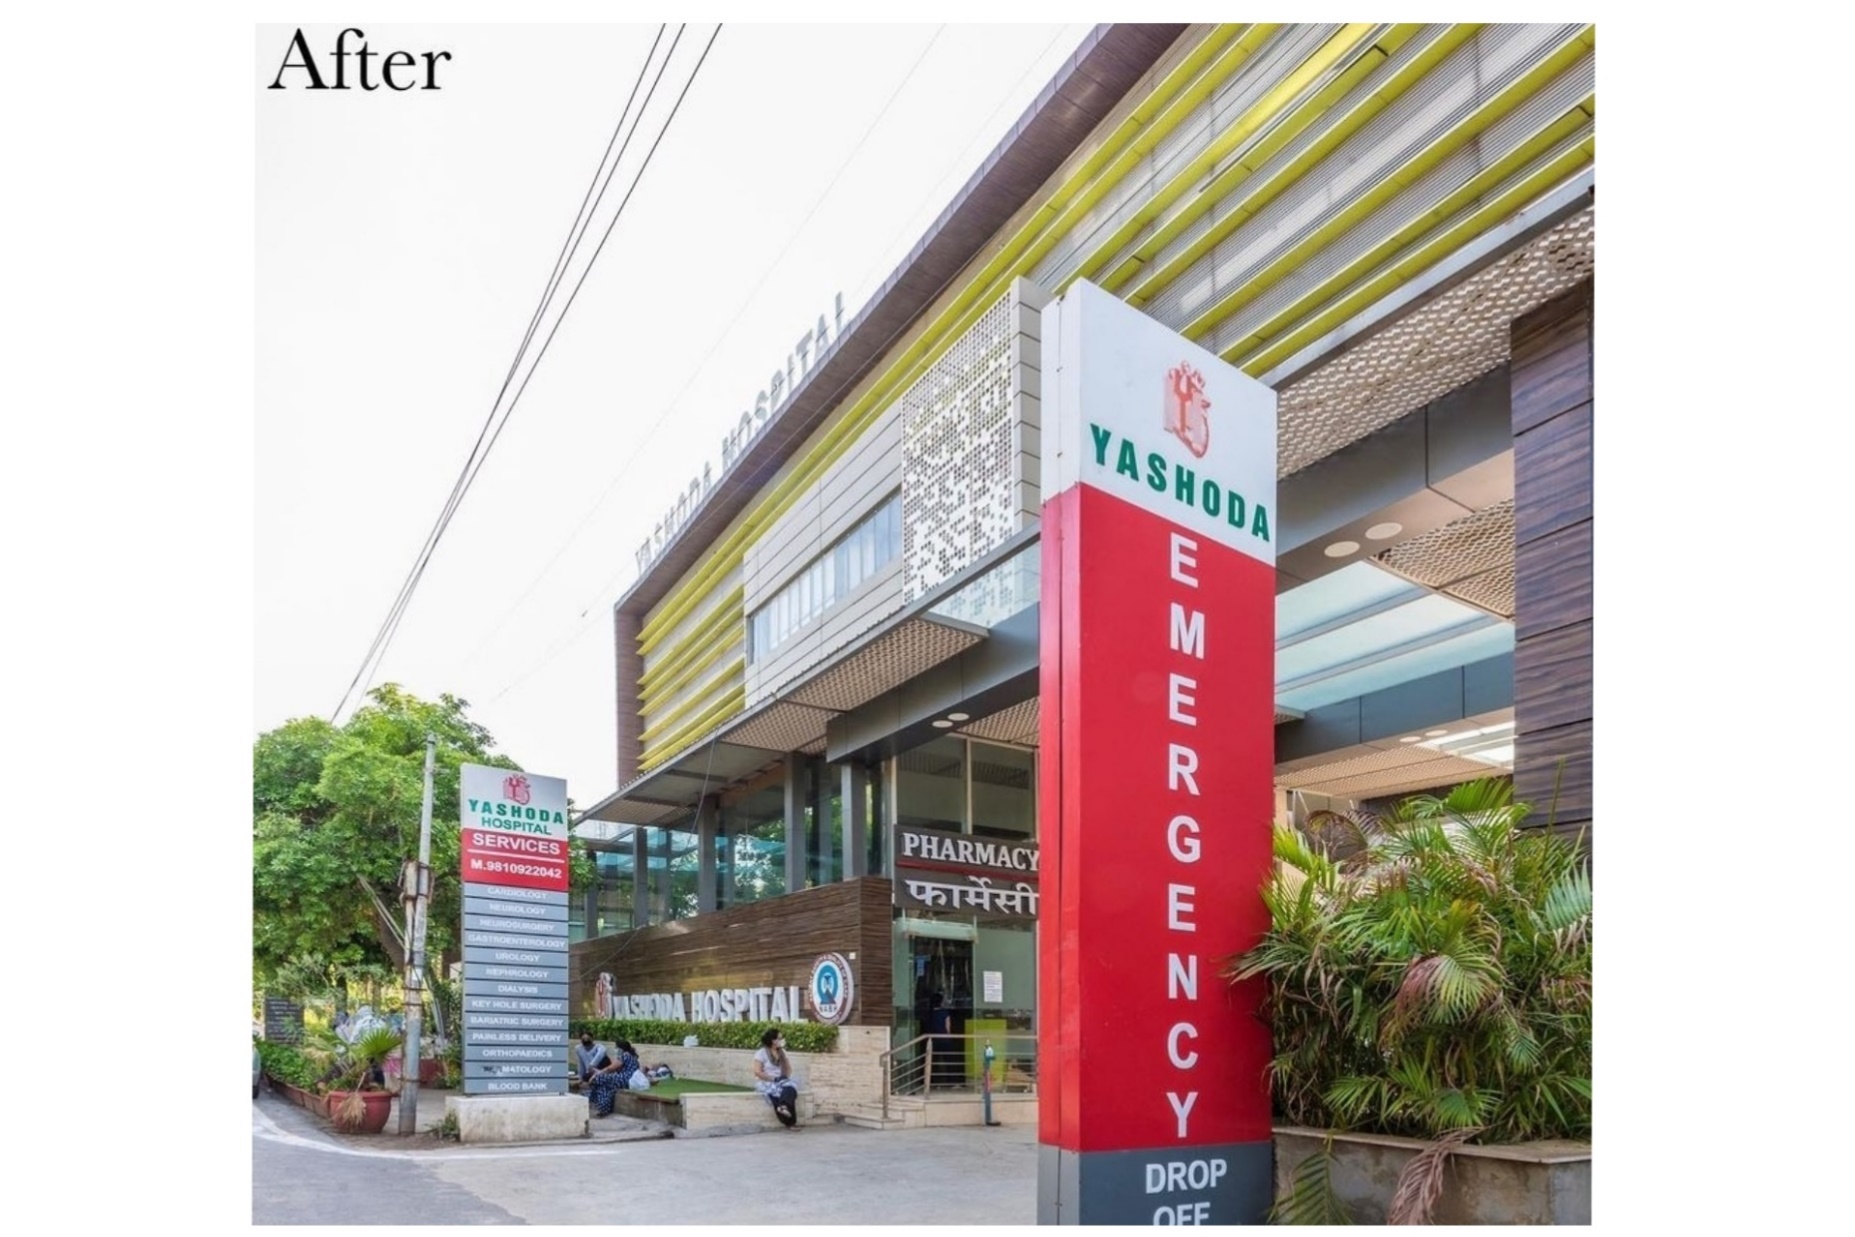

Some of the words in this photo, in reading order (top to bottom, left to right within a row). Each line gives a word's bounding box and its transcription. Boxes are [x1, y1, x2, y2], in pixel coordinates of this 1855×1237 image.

[1089, 422, 1270, 543] YASHODA
[468, 799, 564, 824] YASHODA
[481, 816, 553, 836] HOSPITAL
[1166, 531, 1205, 1139] EMERGENCY
[472, 832, 561, 855] SERVICES
[902, 832, 1040, 871] PHARMACY
[487, 887, 547, 900] CARDIOLOGY
[489, 903, 547, 915] NEUROLOGY
[480, 918, 555, 932] NEUROSURGERY
[468, 933, 566, 949] GASTROENTEROLOGY
[495, 952, 540, 963] UROLOGY
[485, 967, 549, 979] NEPHROLOGY
[497, 984, 539, 995] DIALYSIS
[471, 1000, 491, 1009] KEY
[493, 1000, 518, 1010] HOLE
[520, 1001, 563, 1012] SURGERY
[612, 992, 687, 1023] YASHODA
[691, 985, 808, 1024] HOSPITAL
[470, 1016, 519, 1026] BARIATRIC
[522, 1017, 564, 1027] SURGERY
[472, 1032, 518, 1042] PAINLESS
[520, 1033, 562, 1043] DELIVERY
[482, 1049, 553, 1058] ORTHOPAEDICS
[487, 1082, 520, 1091] BLOOD
[522, 1082, 548, 1091] BANK
[1145, 1158, 1228, 1195] DROP
